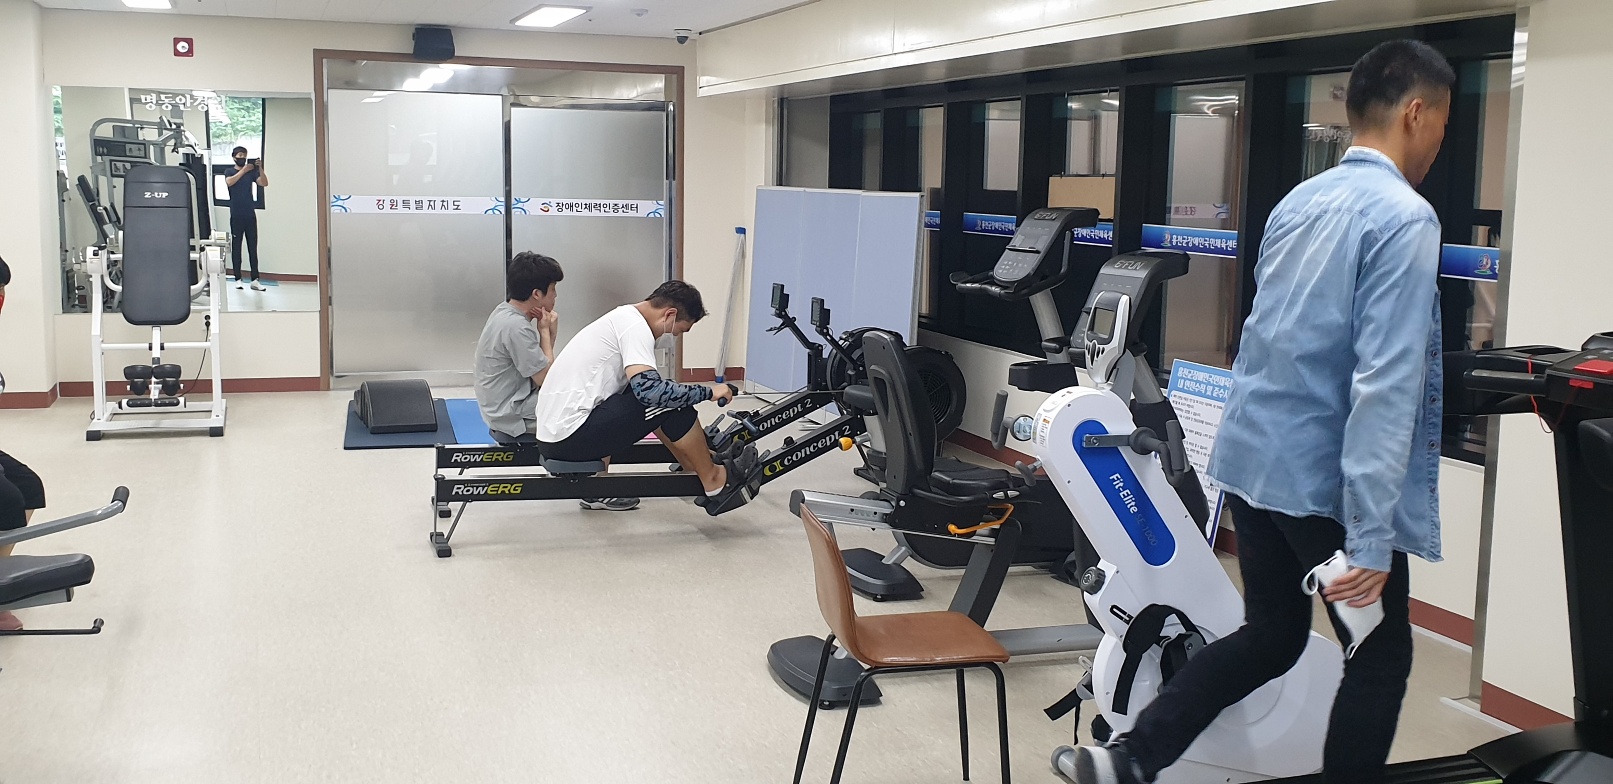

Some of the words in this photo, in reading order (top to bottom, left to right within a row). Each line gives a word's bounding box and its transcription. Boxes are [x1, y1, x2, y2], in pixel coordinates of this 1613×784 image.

[144, 191, 168, 199] Z-UP
[376, 198, 461, 211] 강원특별자치도
[555, 202, 640, 214] 장애인체력인증센터
[1177, 366, 1233, 388] 홍천군장애인국민체육
[757, 404, 803, 431] oncept
[804, 398, 813, 408] 2
[783, 430, 842, 466] concept
[842, 425, 851, 435] 2
[1109, 473, 1138, 514] Fit-Elite
